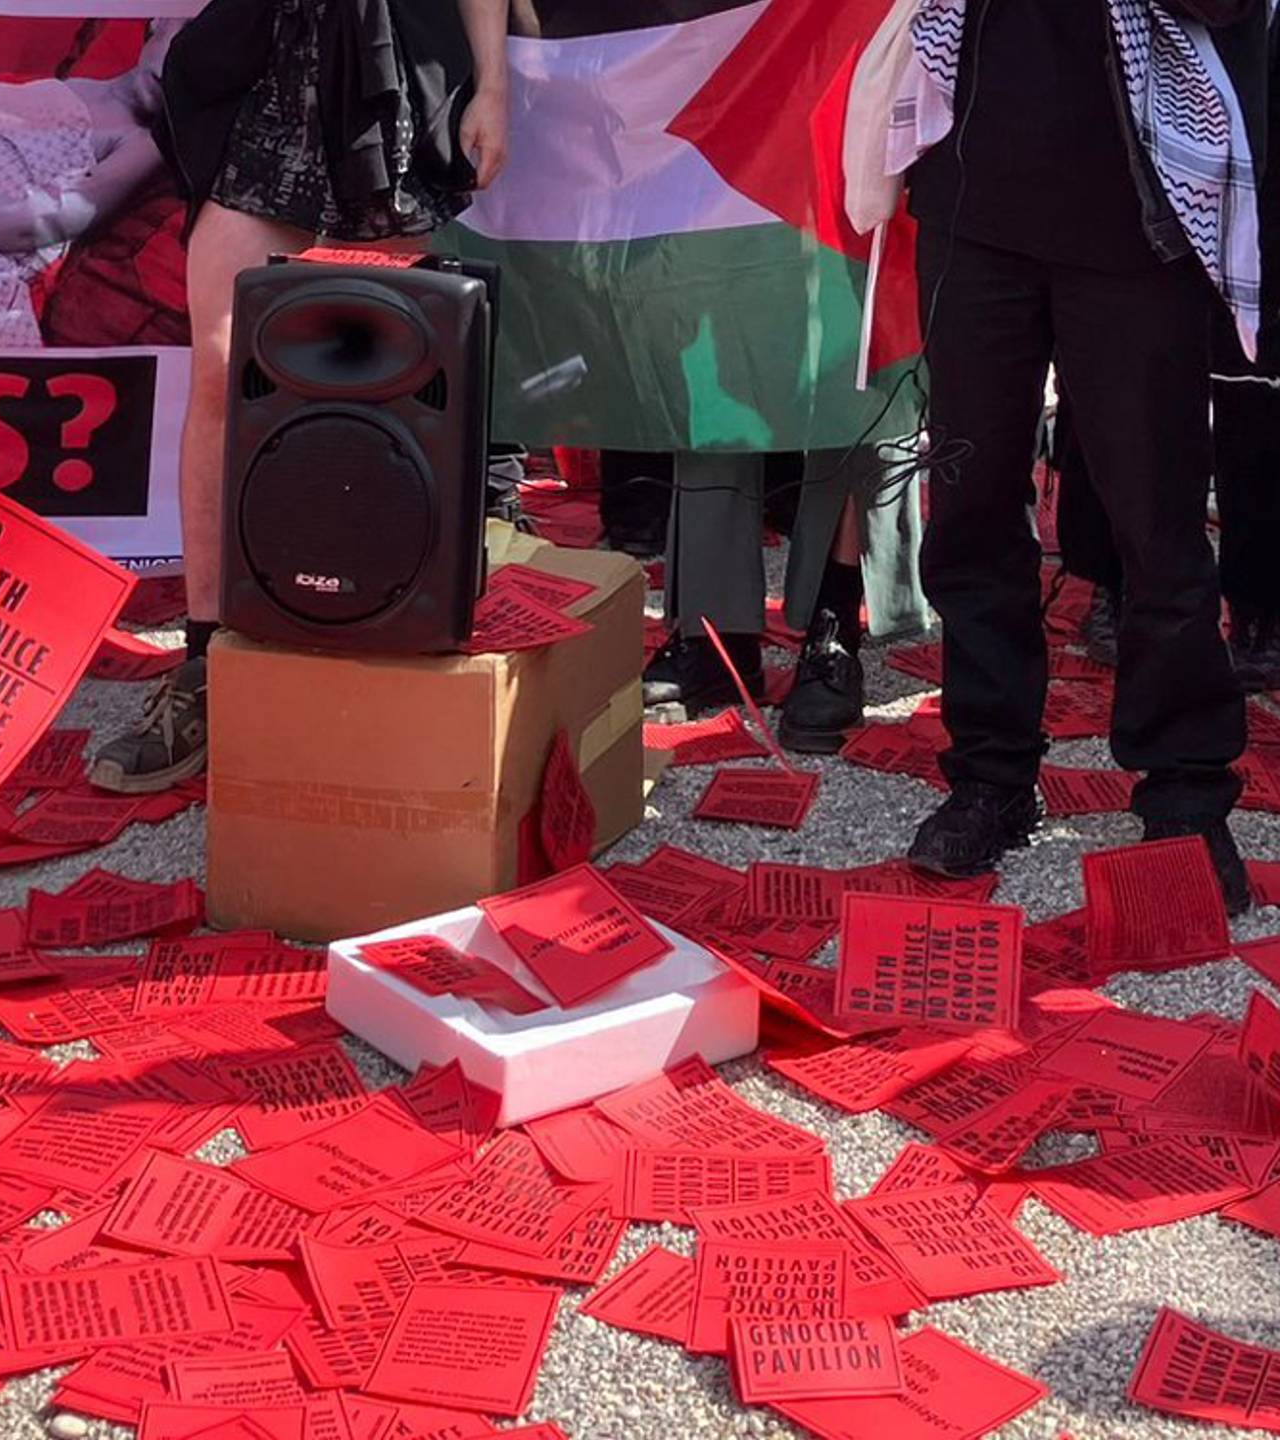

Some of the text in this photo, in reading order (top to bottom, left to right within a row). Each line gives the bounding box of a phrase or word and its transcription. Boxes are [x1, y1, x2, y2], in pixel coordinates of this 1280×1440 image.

[900, 922, 927, 1016] IN VENICE
[927, 928, 953, 1018] NO TO THE
[950, 924, 977, 1022] GENOCIDE
[974, 919, 1001, 1024] PAVILION
[873, 955, 898, 1013] DEATH
[850, 987, 872, 1009] NO
[502, 1140, 532, 1158] NO
[476, 1166, 502, 1184] IN
[489, 1152, 555, 1180] DEATH
[463, 1179, 492, 1197] NO
[495, 1185, 519, 1204] TO
[449, 1190, 555, 1227] GENOCIDE
[710, 1199, 826, 1235] PAVILION
[865, 1192, 977, 1220] PAVILION
[885, 1207, 987, 1230] GENOCIDE
[436, 1200, 549, 1243] PAVILION
[904, 1218, 1001, 1243] NO TO THE
[915, 1238, 988, 1258] VENICE
[961, 1248, 1029, 1271] DEATH
[715, 1254, 838, 1272] PAVILION
[722, 1271, 837, 1286] GENOCIDE
[728, 1285, 837, 1300] NO TO THE
[722, 1300, 837, 1319] IN VENICE
[749, 1320, 871, 1347] GENOCIDE
[752, 1344, 883, 1375] PAVILION
